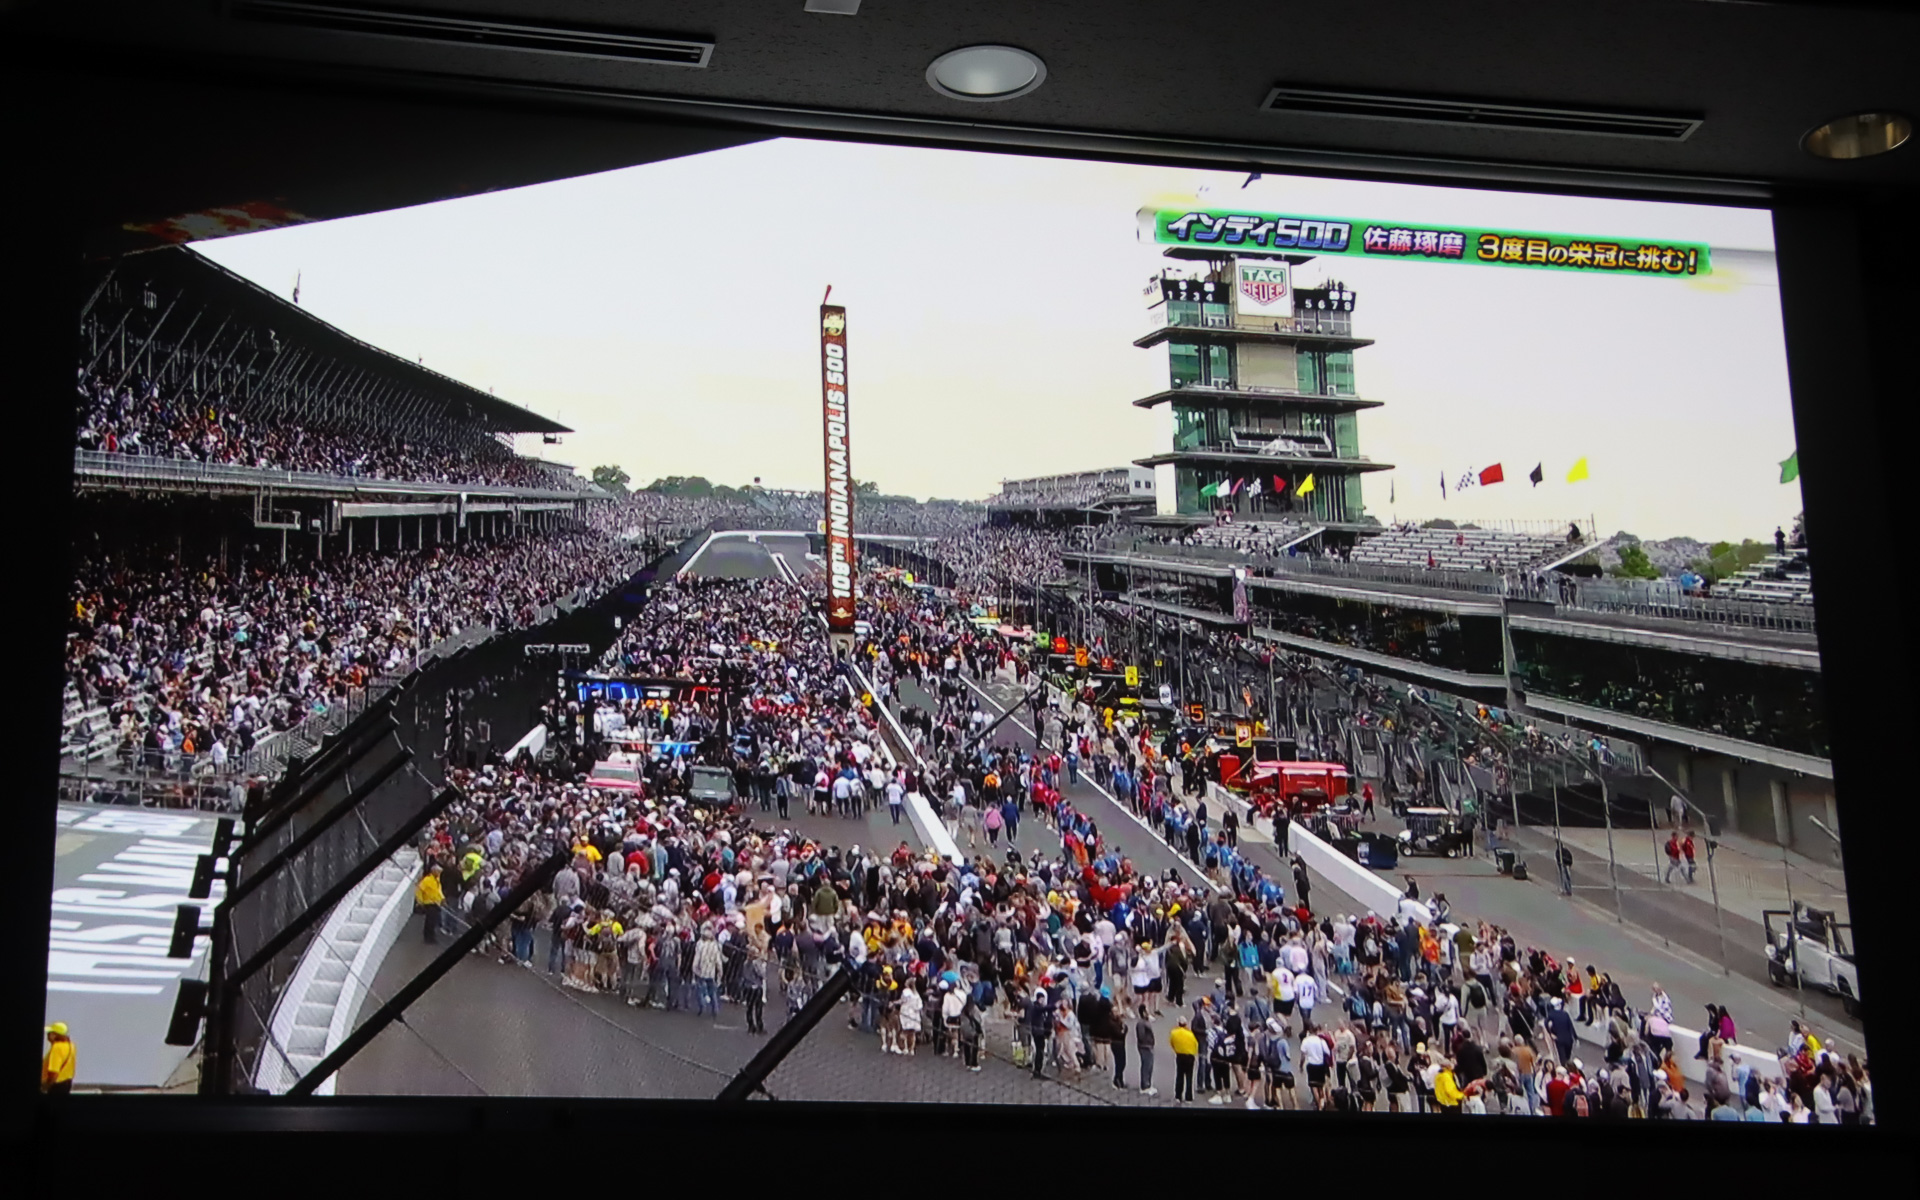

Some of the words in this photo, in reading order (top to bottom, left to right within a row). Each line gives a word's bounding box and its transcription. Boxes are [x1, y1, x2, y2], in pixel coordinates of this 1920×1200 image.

[1168, 212, 1351, 250] インディ500
[1363, 225, 1466, 259] 佐藤琢磨
[1477, 233, 1698, 275] 3度目の栄冠に挑む!
[1243, 268, 1284, 283] TAG
[1167, 290, 1173, 300] 1
[1179, 291, 1187, 301] 2
[1193, 291, 1200, 302] 3
[1205, 293, 1213, 302] 4
[1243, 282, 1286, 302] HEUER
[1305, 298, 1312, 309] 5
[1317, 299, 1326, 310] 6
[1331, 300, 1338, 310] 7
[1344, 301, 1352, 311] 8
[826, 342, 845, 386] 500
[828, 388, 849, 537] INDIANAPOLIS
[831, 541, 851, 599] 108TH
[1190, 703, 1204, 722] 5
